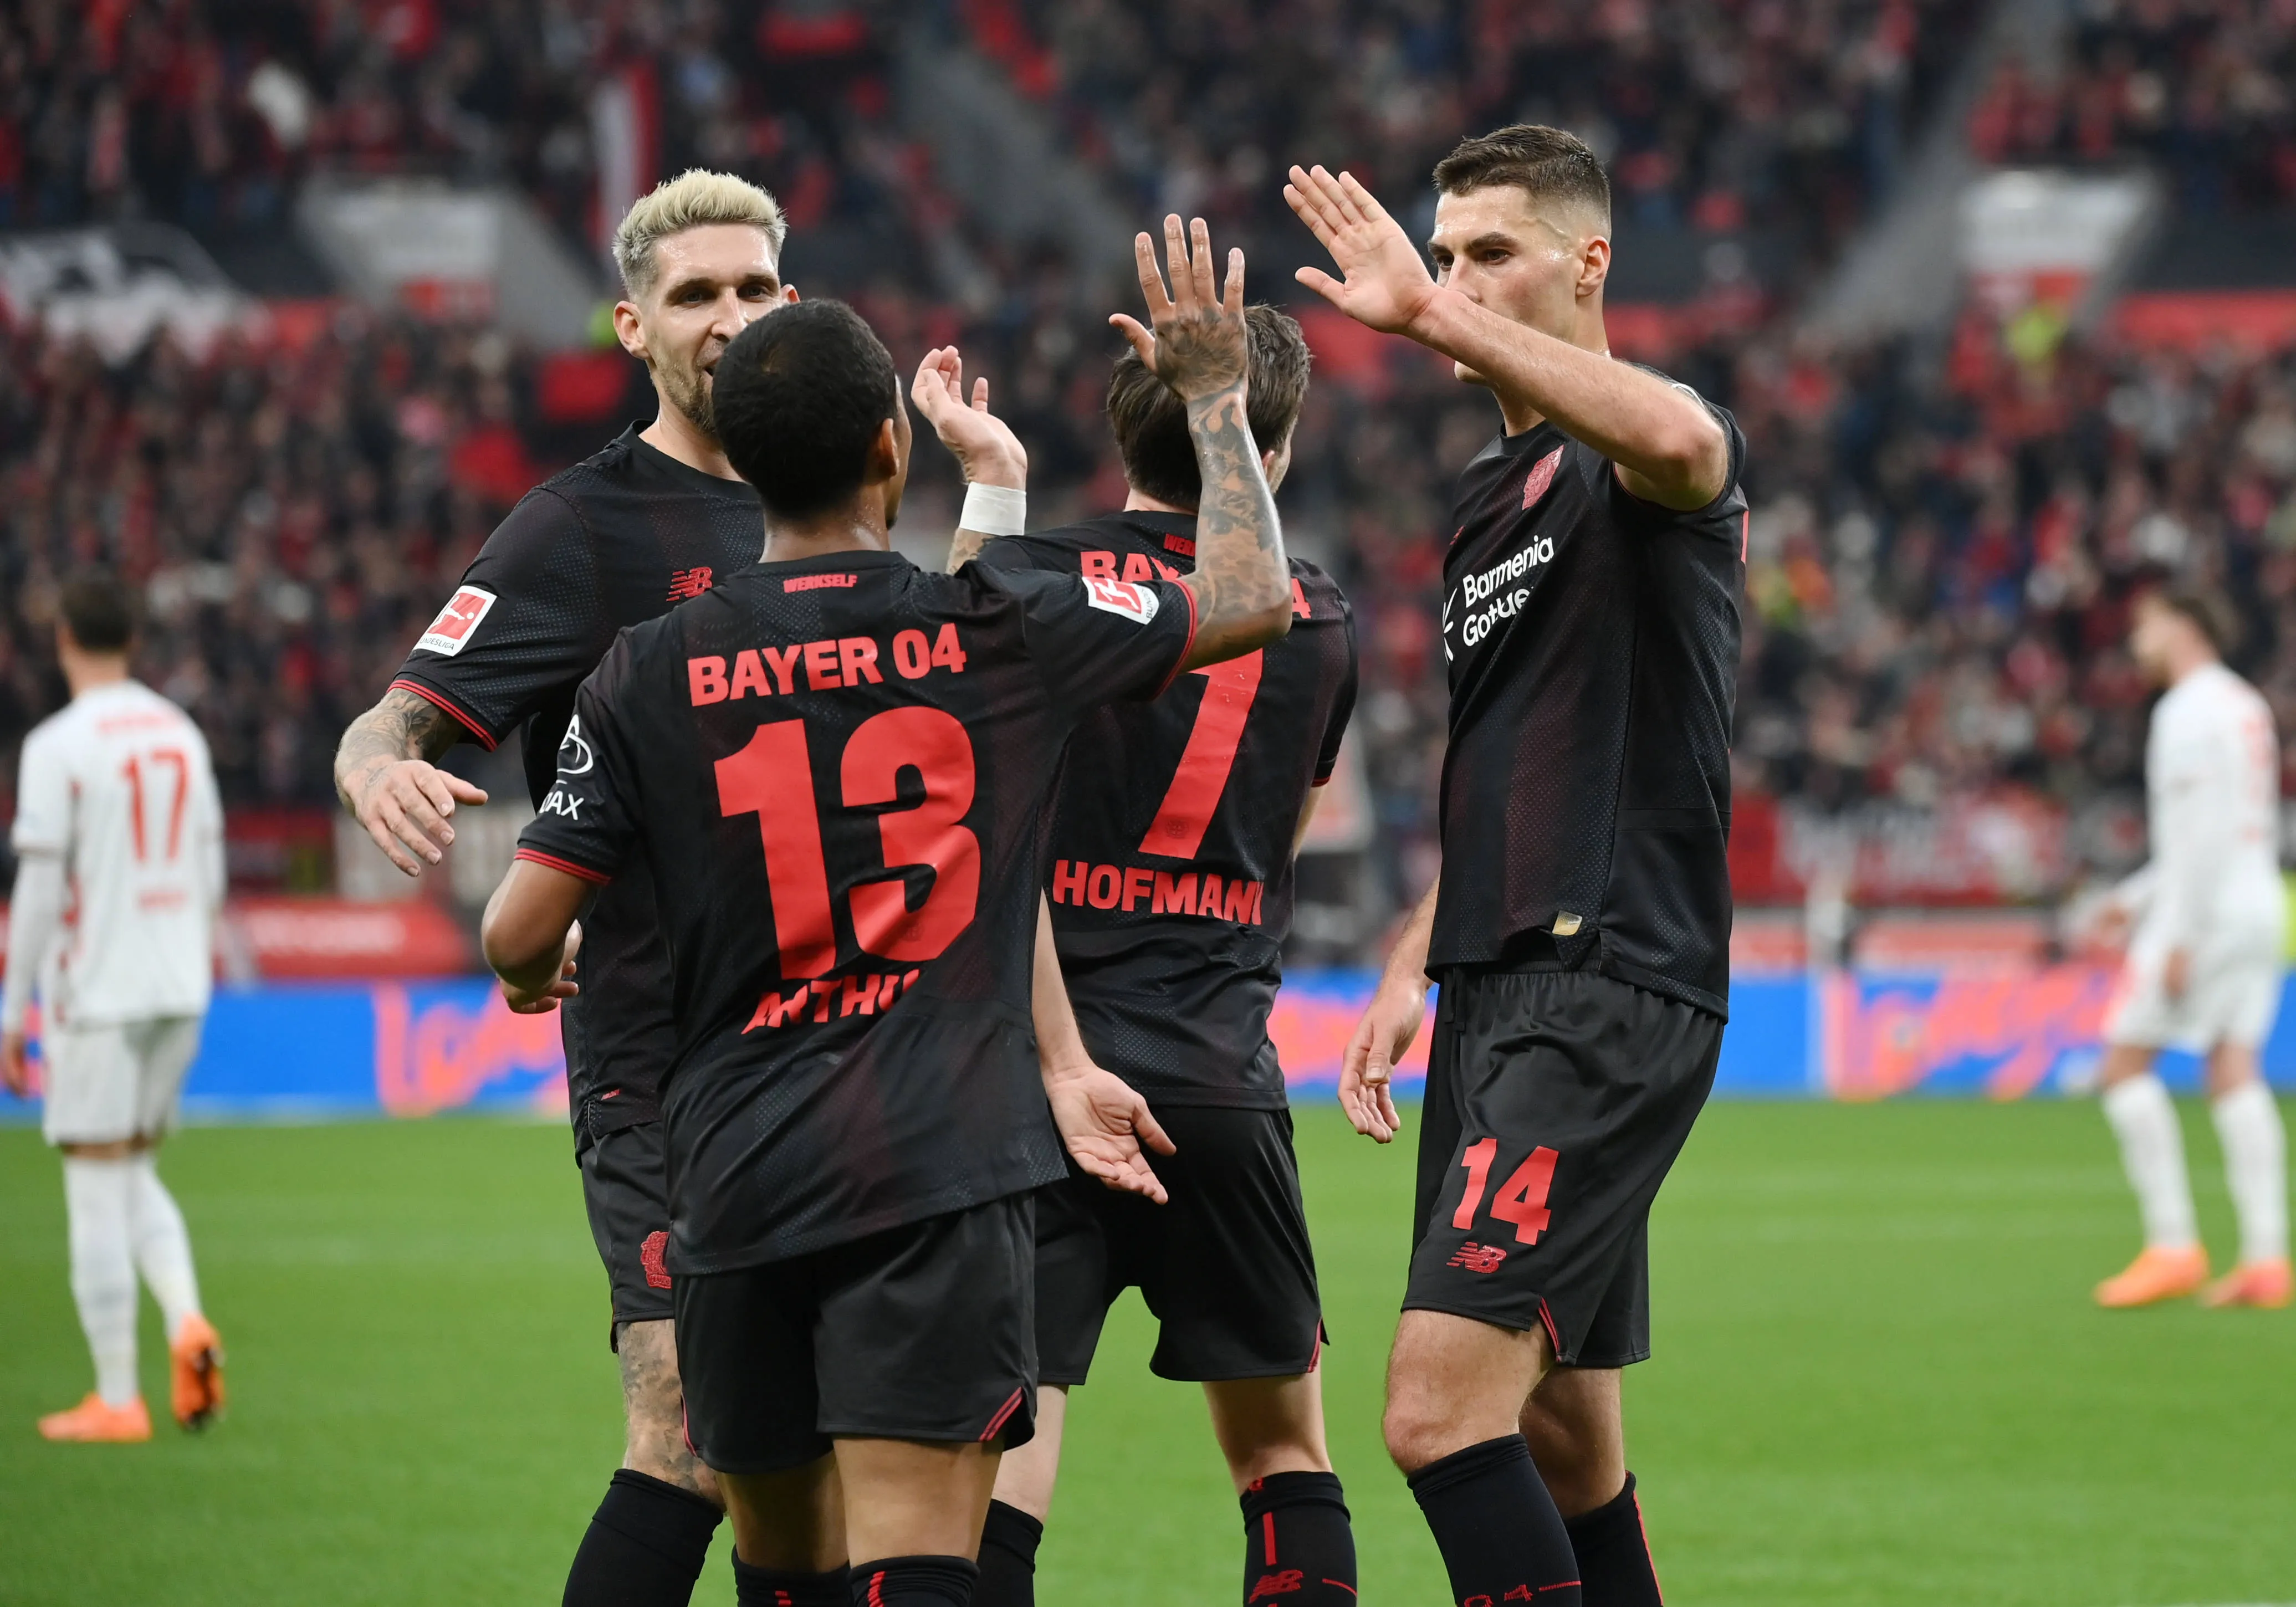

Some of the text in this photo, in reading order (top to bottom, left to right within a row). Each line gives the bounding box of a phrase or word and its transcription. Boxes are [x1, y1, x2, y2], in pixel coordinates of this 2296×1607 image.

[784, 574, 857, 593] WERKSELF
[1081, 551, 1312, 619] BAY 4
[1463, 535, 1554, 608] Barmenia
[419, 637, 454, 650] UNDESLIGA
[687, 623, 967, 707] BAYER 04
[123, 747, 189, 862] 17
[714, 706, 981, 980] 13
[741, 969, 919, 1035] ARTHU
[1452, 1138, 1559, 1245] 14
